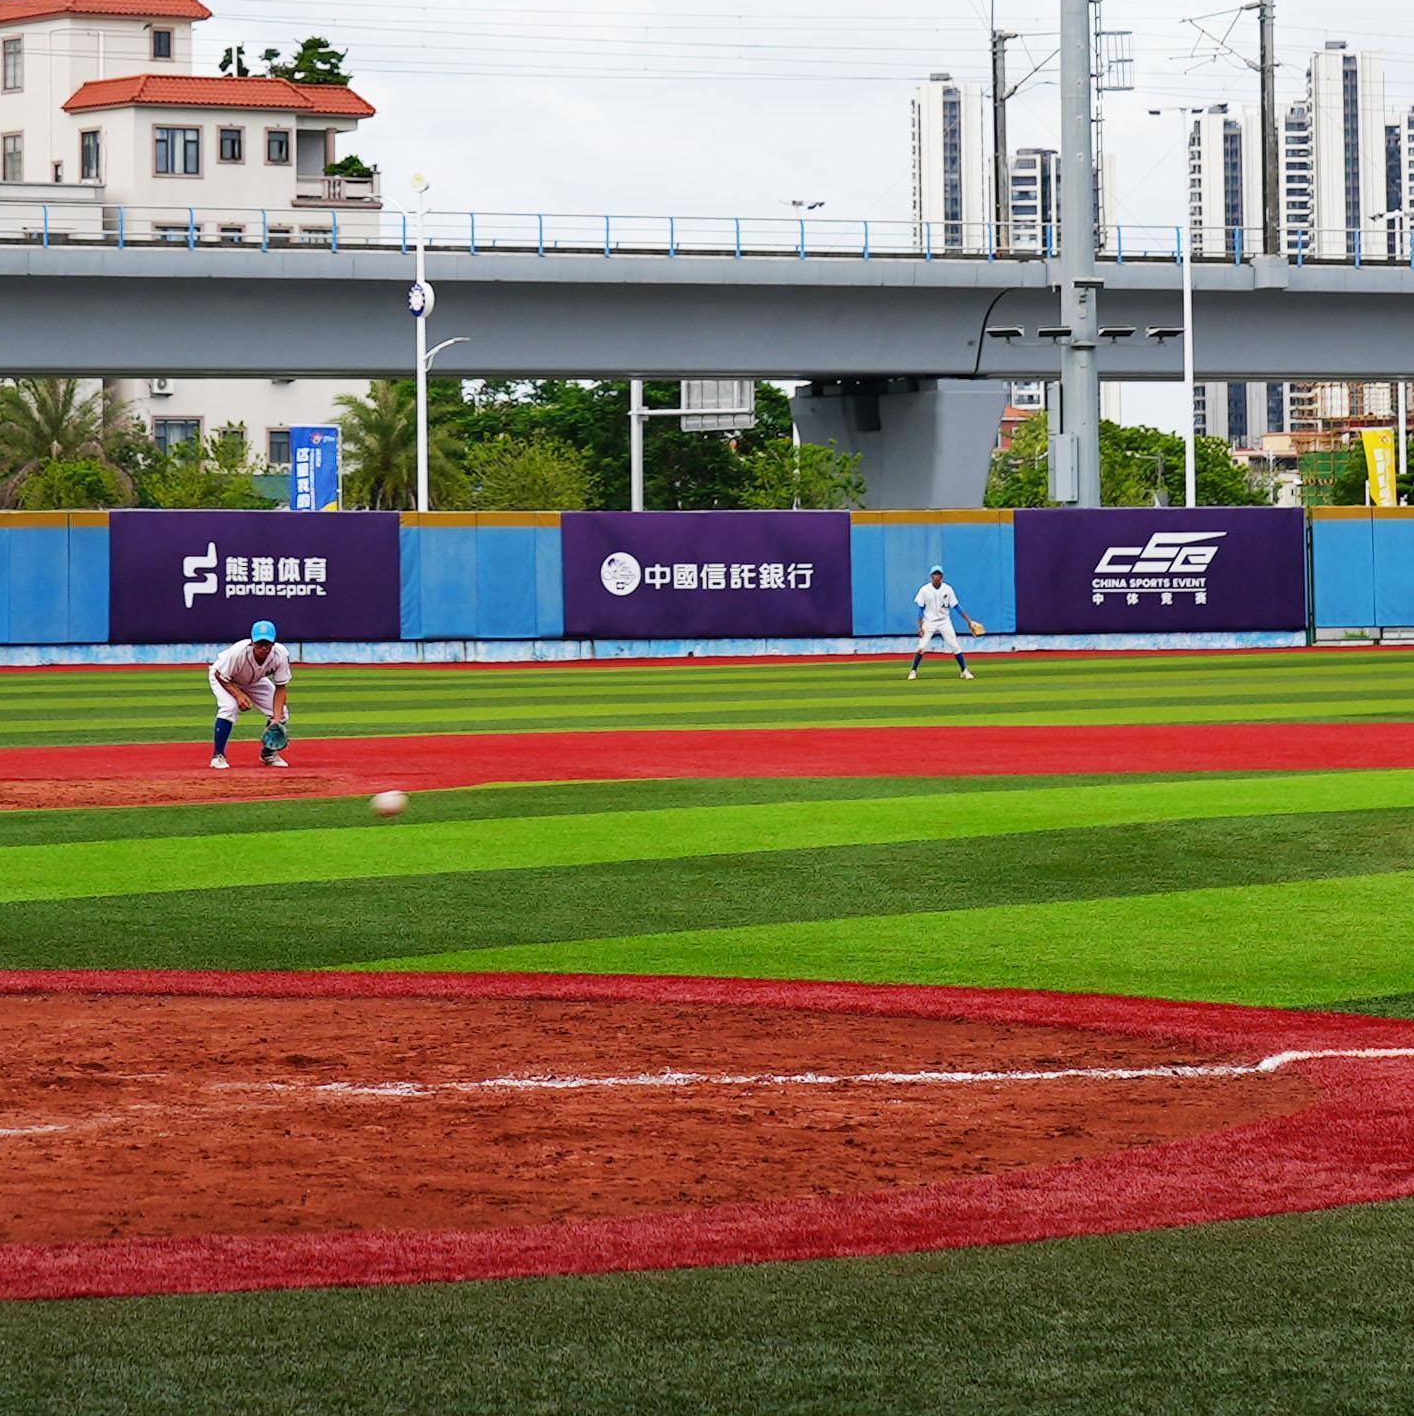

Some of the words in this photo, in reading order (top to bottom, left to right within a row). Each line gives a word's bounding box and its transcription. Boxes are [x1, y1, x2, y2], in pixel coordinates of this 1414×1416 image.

[225, 557, 327, 582] 熊猫体育
[644, 563, 814, 590] 中國信託銀行
[225, 582, 327, 599] pandasport
[1092, 578, 1127, 588] CHINA
[1129, 578, 1170, 588] SPORTS
[1172, 577, 1207, 587] EVENT
